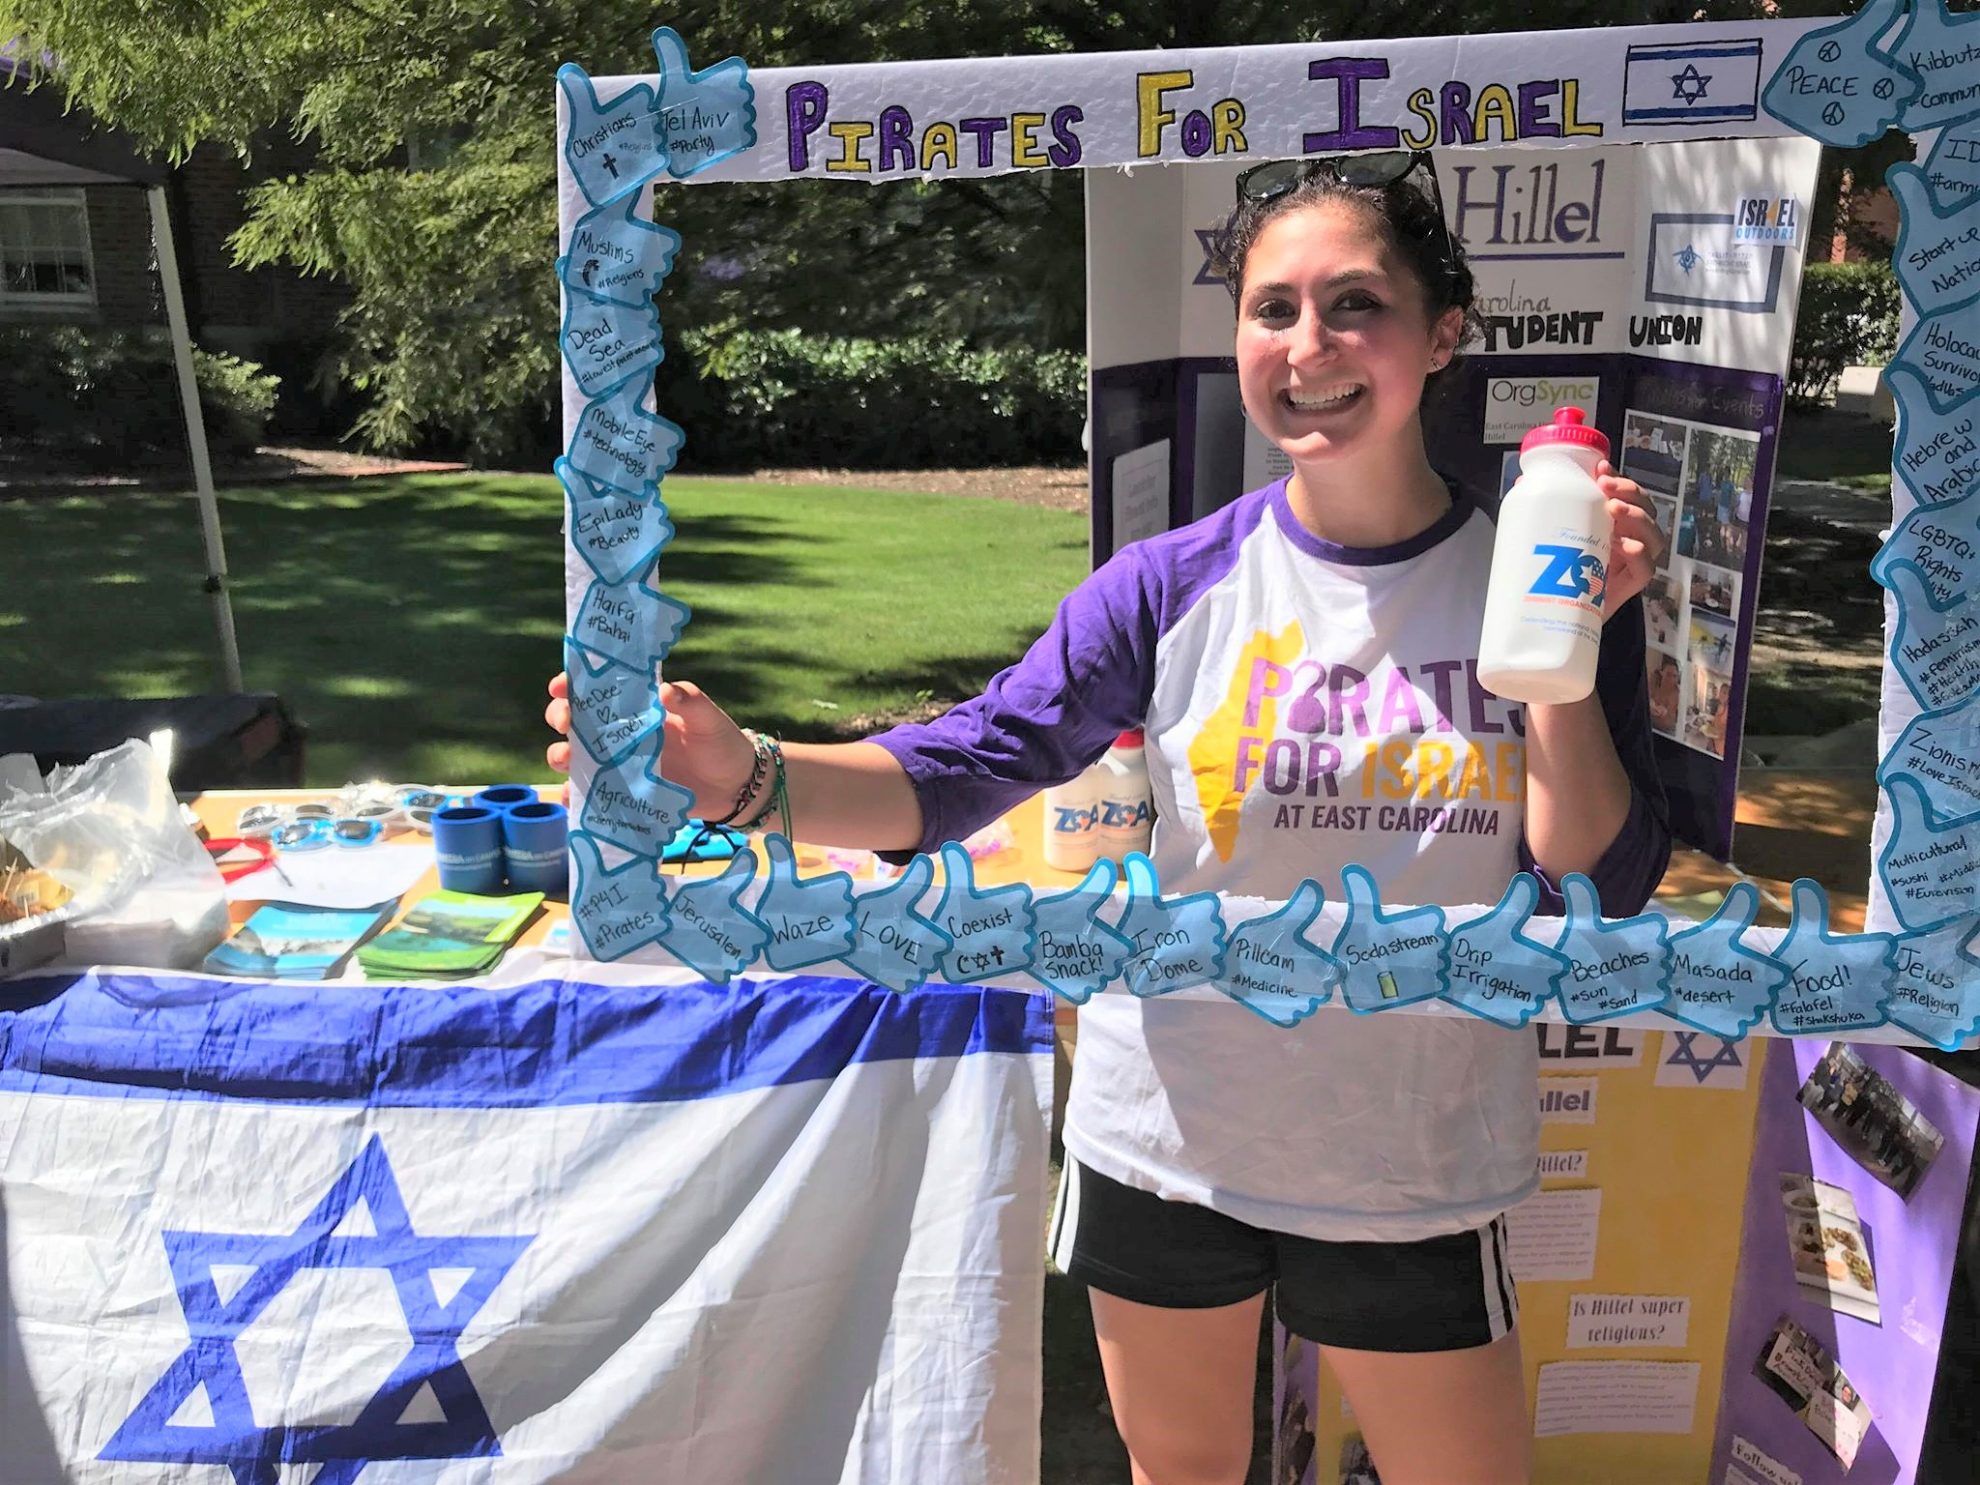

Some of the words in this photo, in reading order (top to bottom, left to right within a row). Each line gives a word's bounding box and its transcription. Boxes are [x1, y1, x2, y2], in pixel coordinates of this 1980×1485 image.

[1786, 66, 1860, 96] PEACE
[664, 109, 685, 132] Tel
[692, 106, 729, 130] Aviv
[786, 80, 1084, 172] PIRATES
[1137, 70, 1248, 158] FOR
[1302, 57, 1603, 154] ISRAEL
[573, 112, 636, 158] Christians
[670, 134, 715, 157] #Party
[1452, 159, 1605, 245] Hillel
[577, 231, 635, 264] Muslims
[1735, 227, 1795, 240] OUTDOORS
[1908, 237, 1956, 272] Start
[567, 318, 612, 350] Dead
[1477, 310, 1603, 352] TUDENT
[1629, 314, 1703, 348] UNION
[589, 339, 626, 363] Sea
[1492, 380, 1593, 407] OrgSync
[583, 429, 646, 478] #technology
[1944, 436, 1977, 465] and
[1924, 458, 1980, 502] Arabic
[578, 503, 644, 534] EpiLady
[1908, 518, 1976, 560] LGBTQ+
[1913, 545, 1964, 583] Rights
[592, 590, 636, 625] Haifa
[587, 616, 631, 644] #Bahai
[1902, 616, 1979, 664] Hadassah
[592, 713, 644, 753] Israel
[1234, 736, 1342, 797] FOR
[596, 781, 670, 824] Agriculture
[1274, 804, 1305, 829] AT
[1311, 805, 1372, 830] EAST
[1378, 806, 1499, 835] CAROLINA
[1888, 834, 1967, 871] Multicultural
[578, 882, 629, 921] #P4I
[595, 911, 655, 950] #Pirates
[675, 896, 742, 960] Jerusalem
[766, 914, 834, 945] Waze
[859, 911, 923, 965] LOVE
[948, 908, 1013, 940] Coexist
[1038, 930, 1104, 959] Bamba
[1131, 928, 1191, 957] Iron
[1236, 937, 1295, 974] PillCam
[1455, 938, 1493, 968] Drip
[1140, 957, 1204, 984] Dome
[1452, 964, 1532, 1003] Irrigation
[1570, 952, 1650, 983] Beaches
[1672, 954, 1753, 983] Masada
[1791, 958, 1853, 998] Food!
[1896, 947, 1955, 990] Jews
[1231, 975, 1298, 999] #Medicine
[1675, 987, 1736, 1004] #desert
[1896, 987, 1960, 1016] #Religion
[1574, 1301, 1586, 1317] Is
[1592, 1299, 1634, 1315] Hillel
[1641, 1301, 1684, 1317] super
[1588, 1325, 1665, 1344] religious?
[1737, 1444, 1777, 1478] Follow
